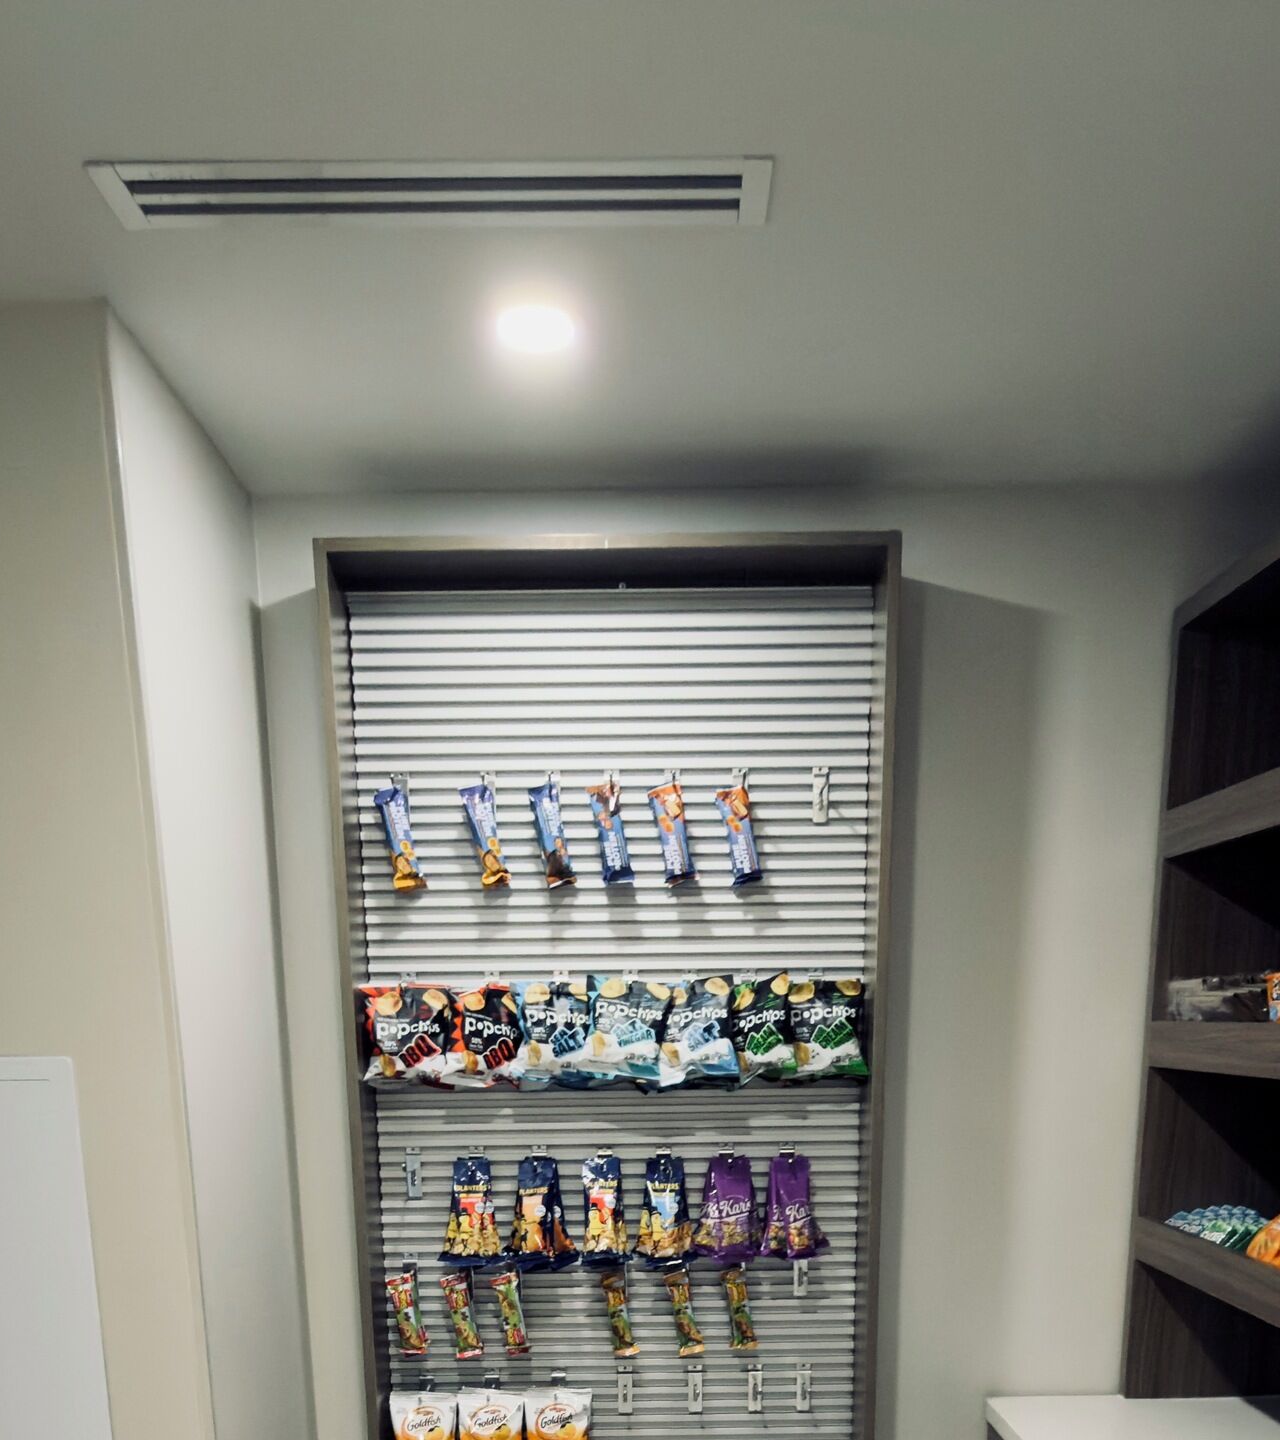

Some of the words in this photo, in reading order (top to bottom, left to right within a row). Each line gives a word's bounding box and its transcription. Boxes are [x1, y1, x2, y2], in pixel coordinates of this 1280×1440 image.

[595, 1001, 663, 1023] popchips
[790, 1007, 857, 1026] popchips
[376, 1019, 441, 1038] popchips
[552, 1031, 585, 1059] SALT
[519, 1187, 549, 1196] PLANTERS
[650, 1182, 680, 1191] PLANTERS
[407, 1416, 441, 1433] Goldfish
[540, 1413, 573, 1430] Goldfish
